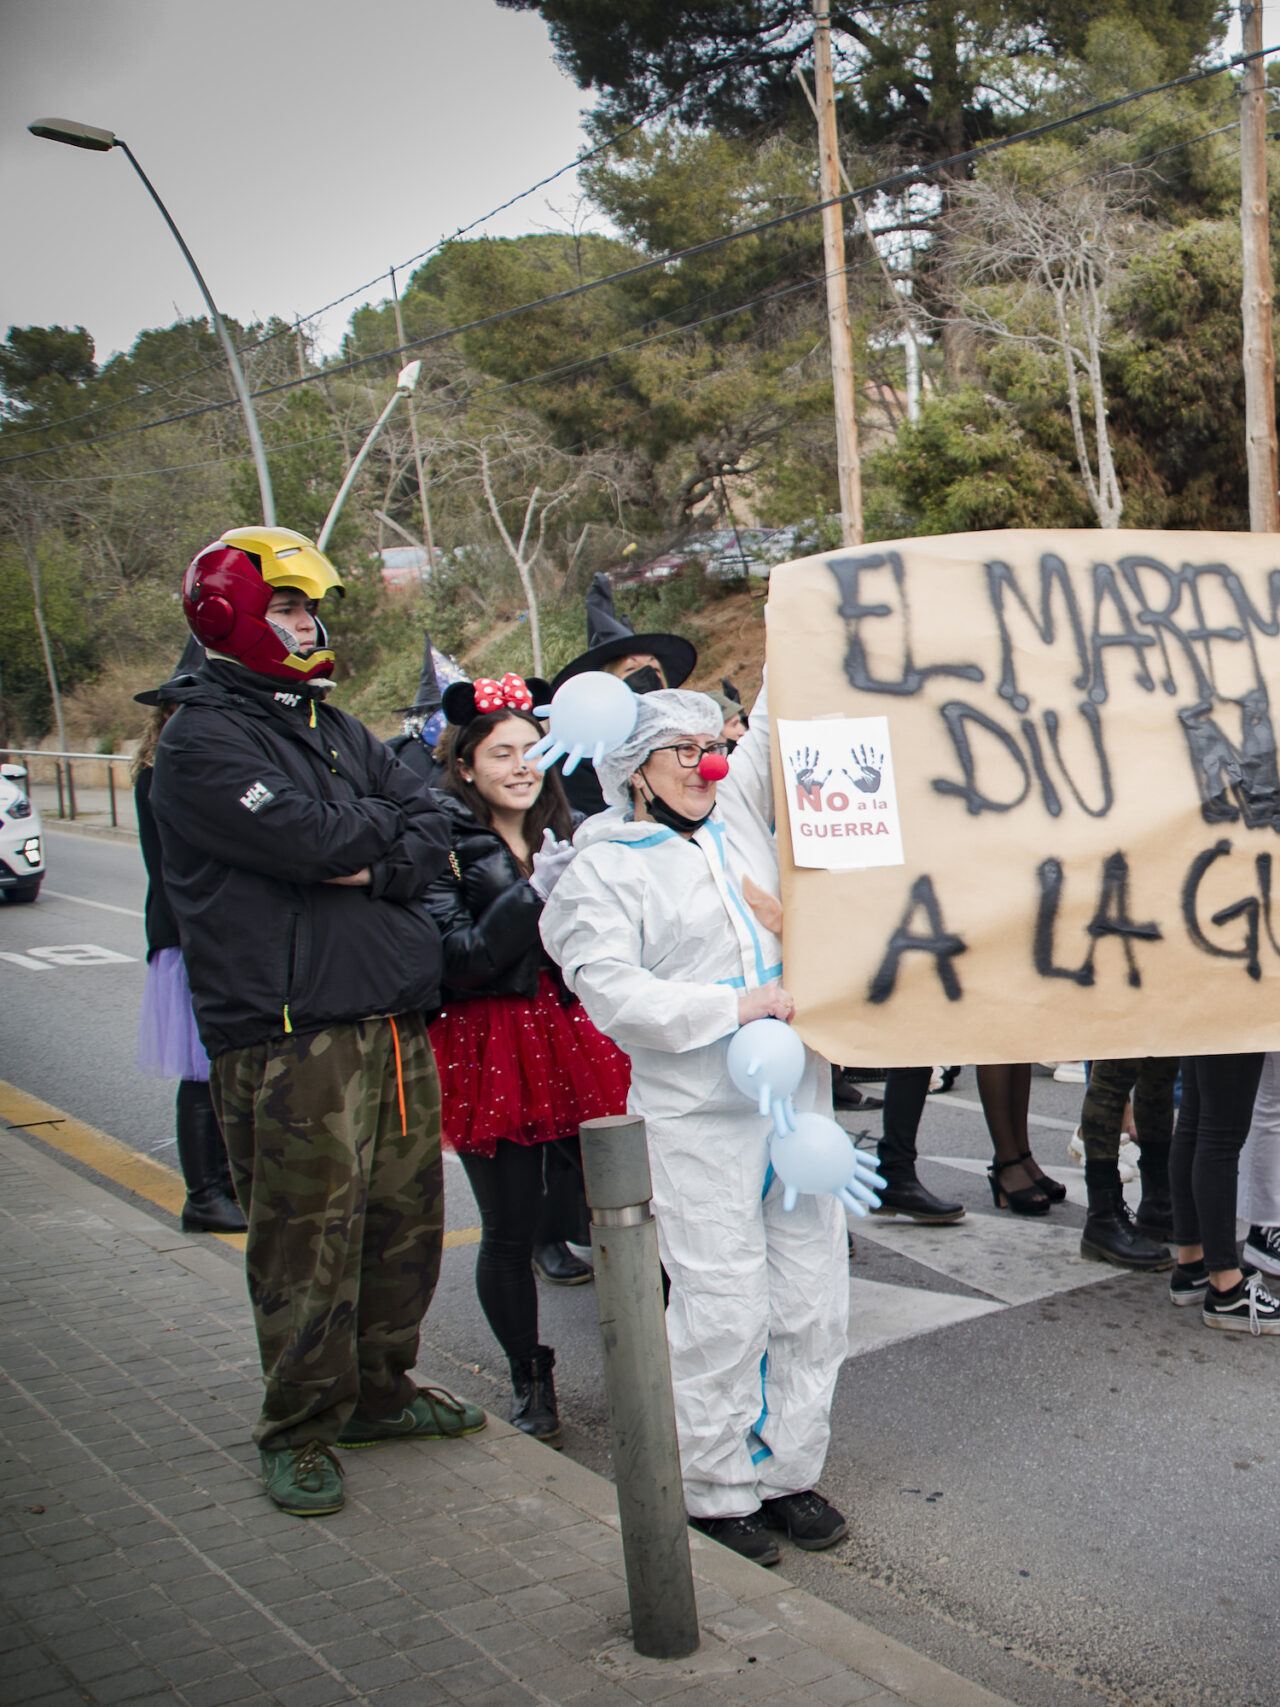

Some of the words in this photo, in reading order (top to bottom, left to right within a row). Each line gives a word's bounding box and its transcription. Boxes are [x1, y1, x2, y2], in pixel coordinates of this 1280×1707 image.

[826, 552, 985, 696] EL
[858, 801, 867, 810] a
[873, 799, 888, 810] la
[931, 701, 1115, 818] DIU
[800, 821, 890, 838] GUERRA
[866, 874, 969, 1002] A
[1031, 850, 1164, 989] LA
